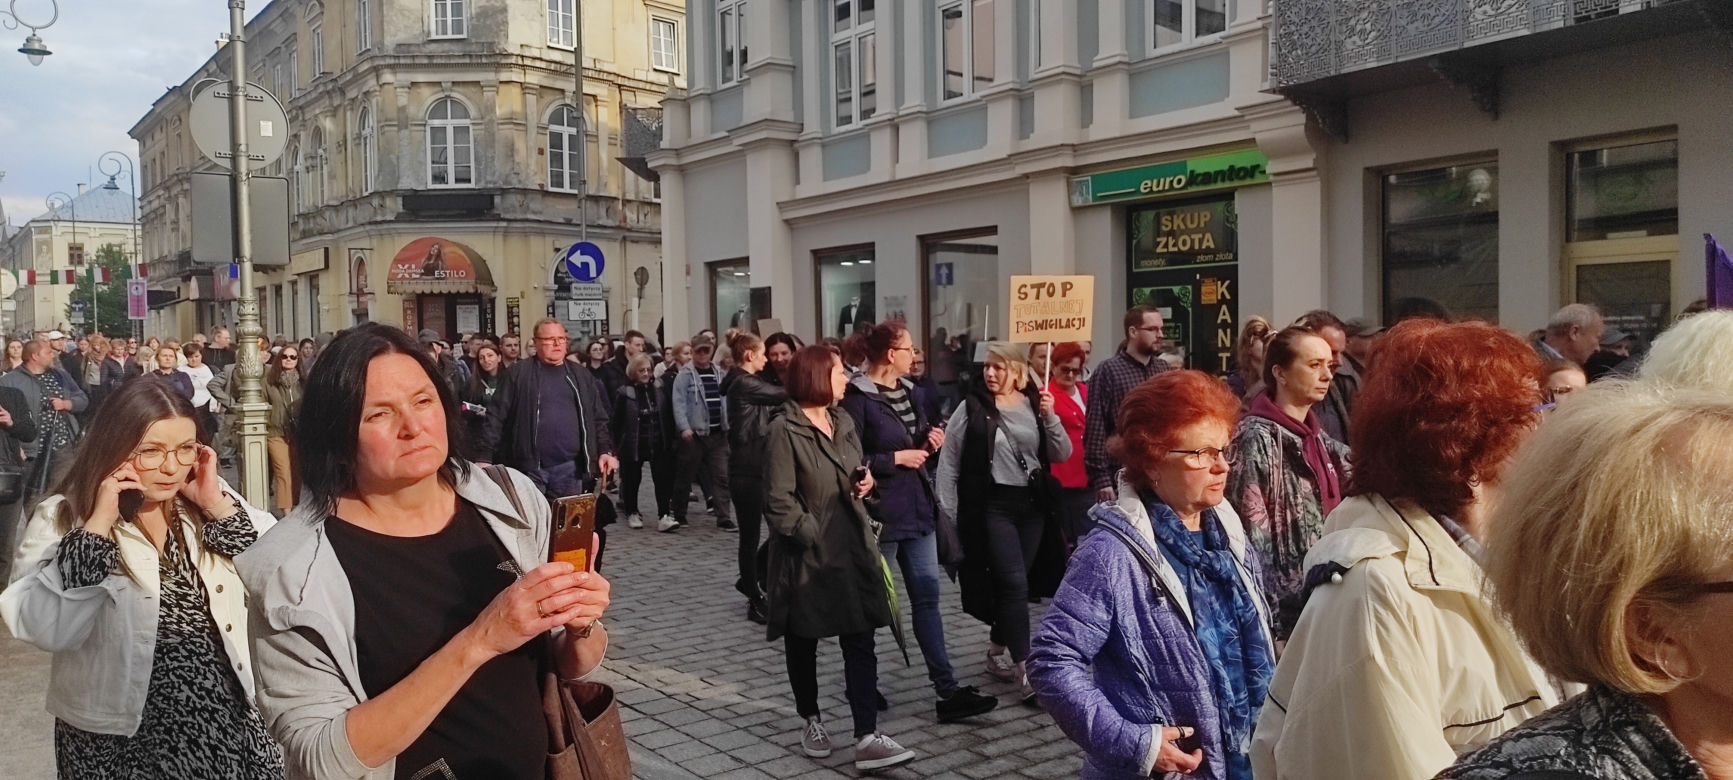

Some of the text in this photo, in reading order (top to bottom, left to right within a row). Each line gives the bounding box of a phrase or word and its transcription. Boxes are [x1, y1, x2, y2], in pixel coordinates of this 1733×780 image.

[1161, 211, 1211, 231] SKUP
[1156, 232, 1215, 253] ZŁOTA
[434, 270, 466, 278] ESTILO
[1017, 281, 1074, 300] STOP
